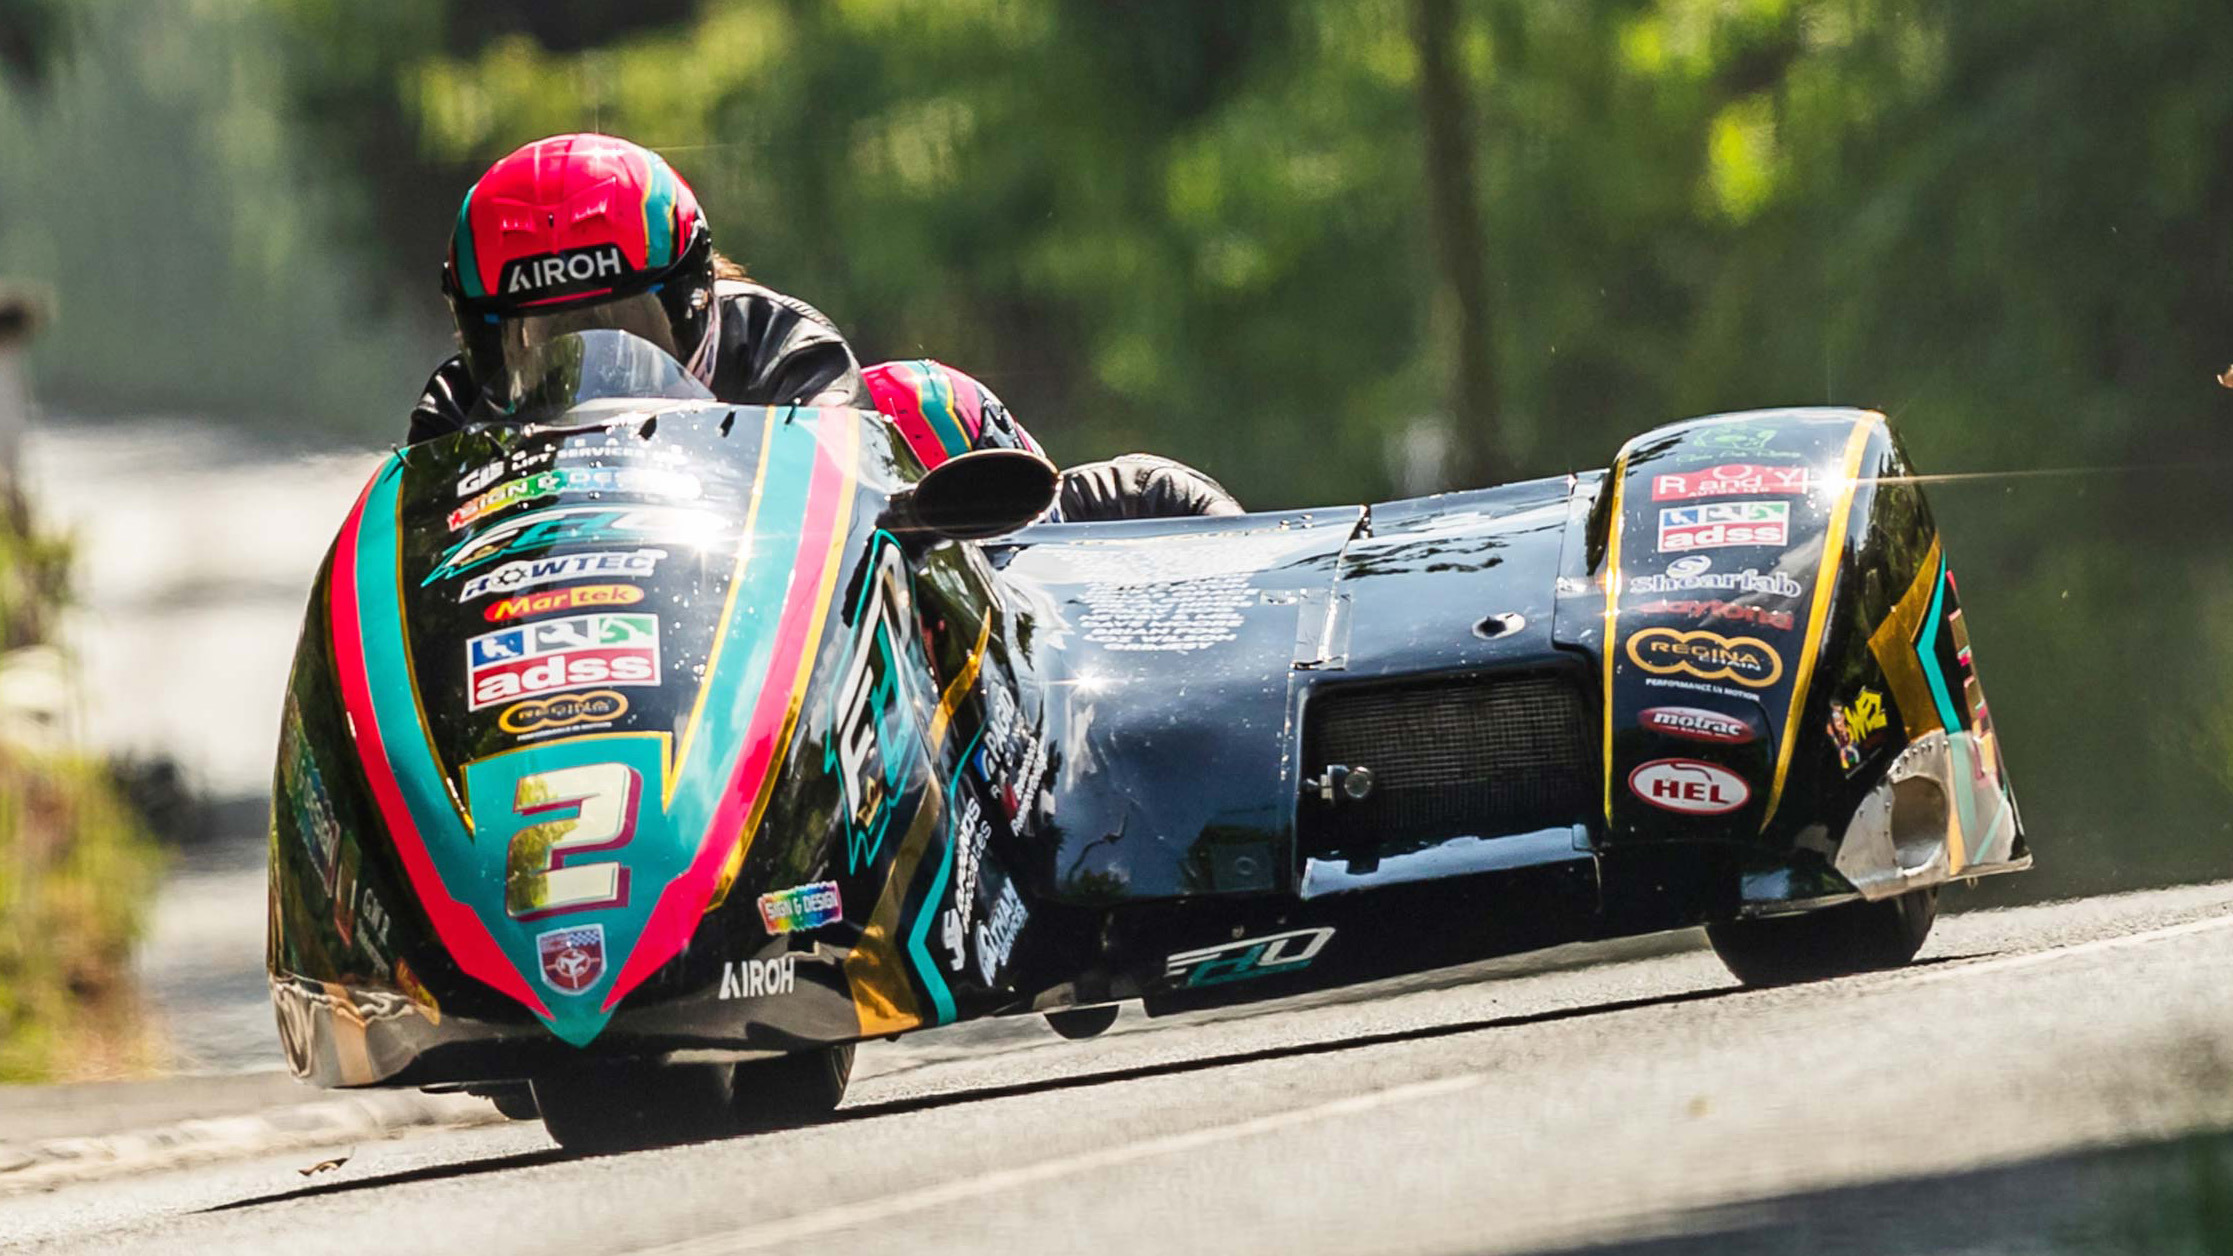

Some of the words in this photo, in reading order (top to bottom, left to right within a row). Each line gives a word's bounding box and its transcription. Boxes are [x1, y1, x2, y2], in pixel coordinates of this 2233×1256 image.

[509, 247, 622, 293] AIROH
[1659, 475, 1686, 494] R
[1699, 475, 1762, 490] and
[1774, 468, 1801, 486] Y
[1663, 524, 1782, 550] adss
[1651, 642, 1760, 664] REGINA
[475, 655, 652, 702] adss
[1654, 713, 1743, 735] motrac
[1653, 779, 1730, 805] HEL
[506, 762, 643, 922] 2
[765, 900, 792, 919] SIGN
[803, 891, 838, 913] DESIGN
[719, 957, 795, 1000] AIROH
